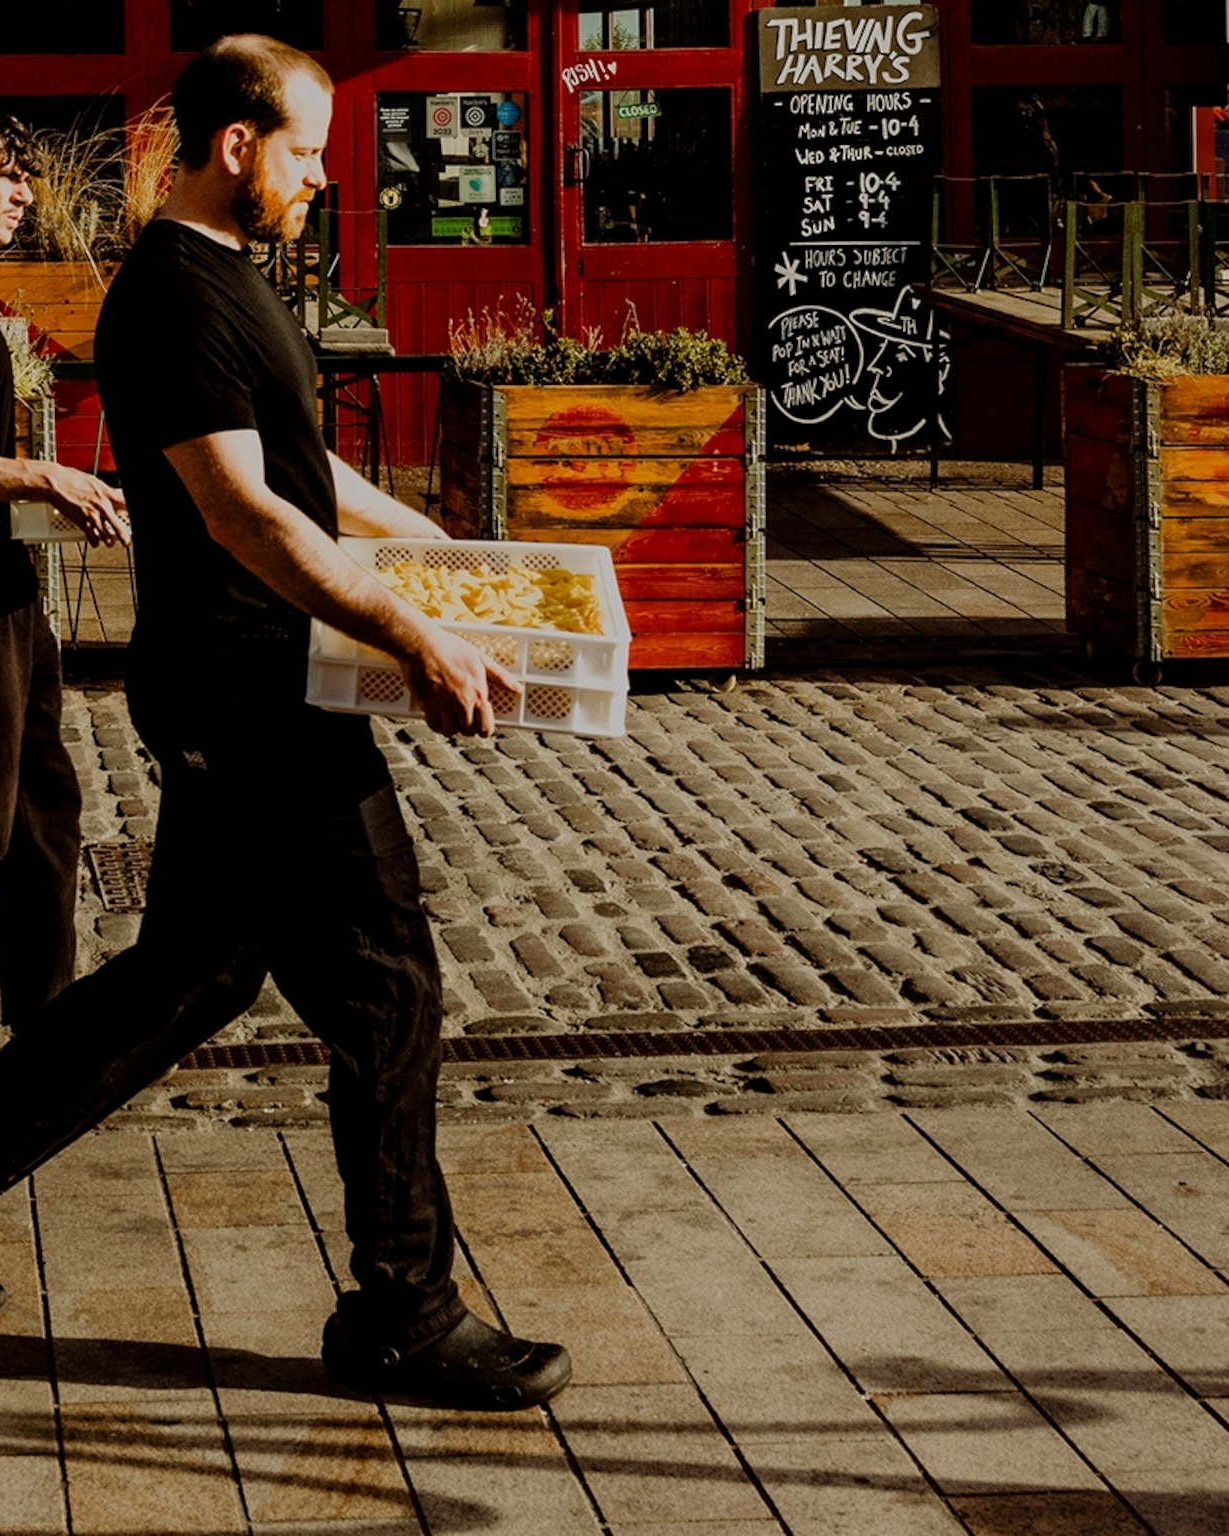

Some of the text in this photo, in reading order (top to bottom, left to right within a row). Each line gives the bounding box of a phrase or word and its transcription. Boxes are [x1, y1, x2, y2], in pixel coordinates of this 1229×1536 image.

[766, 11, 931, 60] THIEVING
[776, 51, 910, 85] HARRY'S
[618, 104, 658, 118] CLOSED
[790, 93, 854, 115] OPENING
[866, 92, 912, 113] HOURS
[797, 122, 826, 140] MON
[828, 120, 839, 137] &
[839, 117, 863, 136] TUE
[795, 148, 825, 166] WED
[839, 144, 873, 162] THUR
[886, 144, 924, 157] CLOSED
[805, 175, 834, 193] FRI
[802, 194, 834, 214] SAT
[801, 215, 835, 237] SUN
[805, 246, 908, 269] HOURS SUBJECT
[819, 270, 897, 289] TO CHANGE
[780, 311, 819, 341] PLEASE
[772, 343, 793, 363] POP
[794, 335, 810, 356] IN
[821, 325, 847, 349] WAIT
[788, 346, 846, 378] FOR A SEAT!
[780, 363, 851, 409] THANK YOU!
